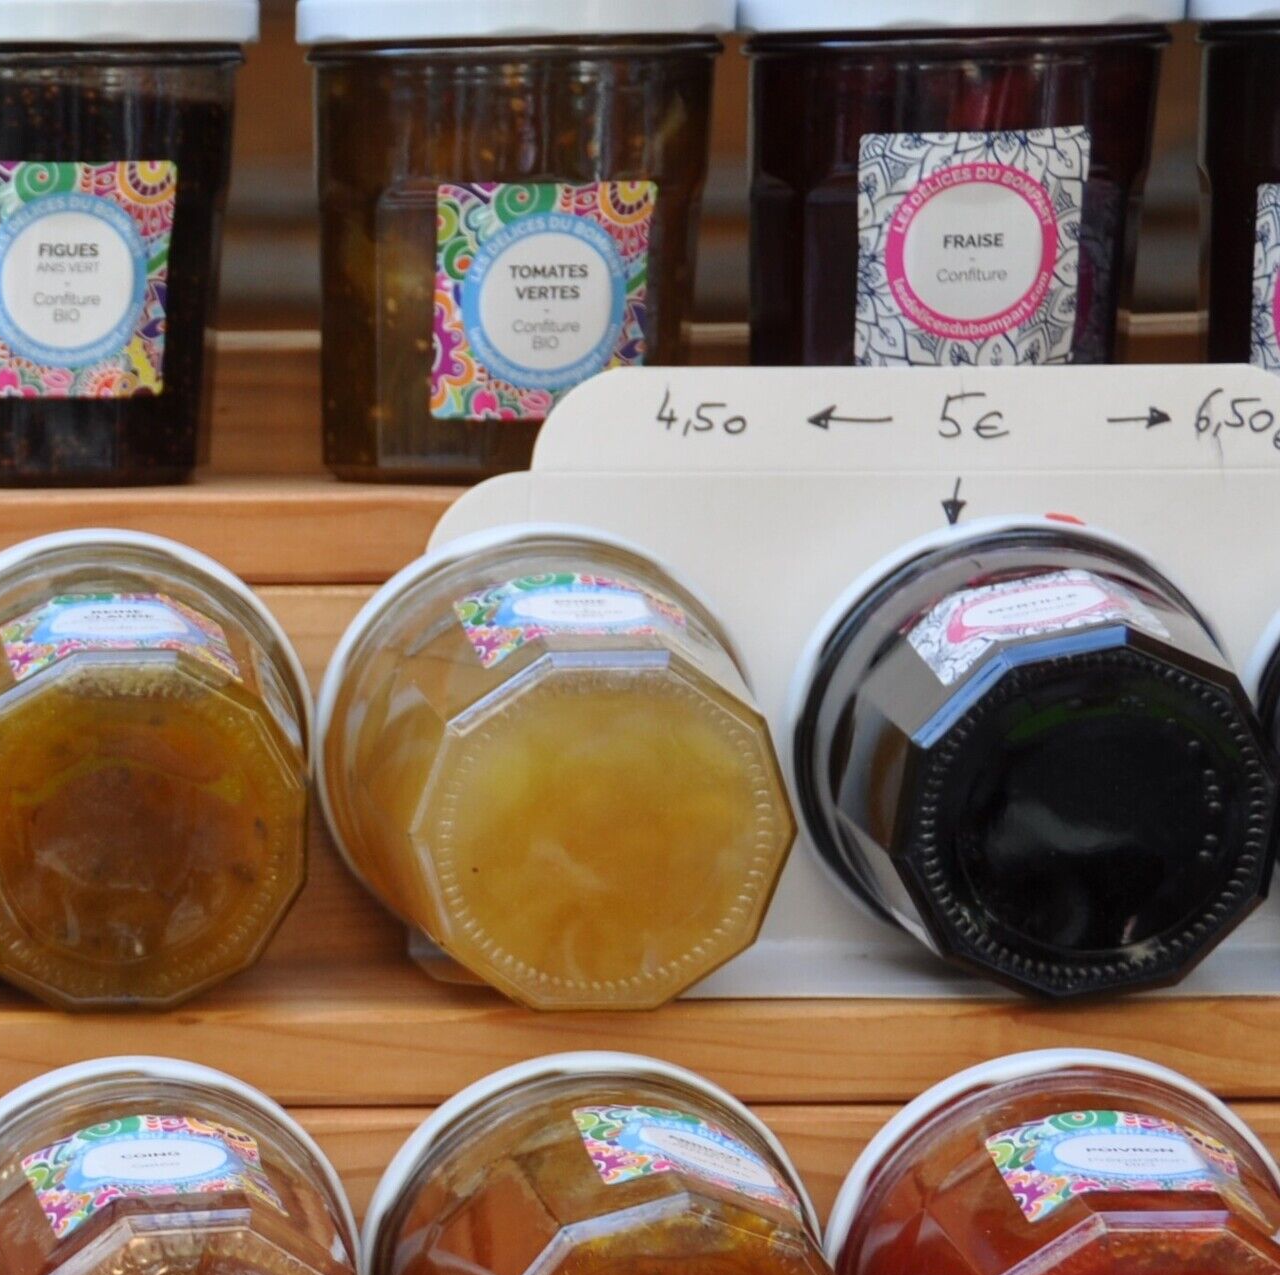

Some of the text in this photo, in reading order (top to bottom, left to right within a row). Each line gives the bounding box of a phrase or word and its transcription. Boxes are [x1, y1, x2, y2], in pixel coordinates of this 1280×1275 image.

[975, 165, 1000, 180] DU
[548, 215, 572, 230] DU
[943, 233, 1004, 248] FRAISE
[38, 243, 100, 258] FIGUES
[36, 260, 100, 273] ANIS VERT
[510, 264, 589, 279] TOMATES
[936, 268, 1008, 282] Confiture
[33, 291, 101, 306] Confiture
[515, 285, 581, 300] VERTES
[53, 307, 81, 323] BIO
[512, 318, 581, 334] Confiture
[532, 335, 559, 350] BIO
[655, 388, 747, 437] 4,50
[938, 392, 1011, 439] 5€
[119, 1151, 181, 1160] COING
[1084, 1146, 1174, 1154] POIVRON
